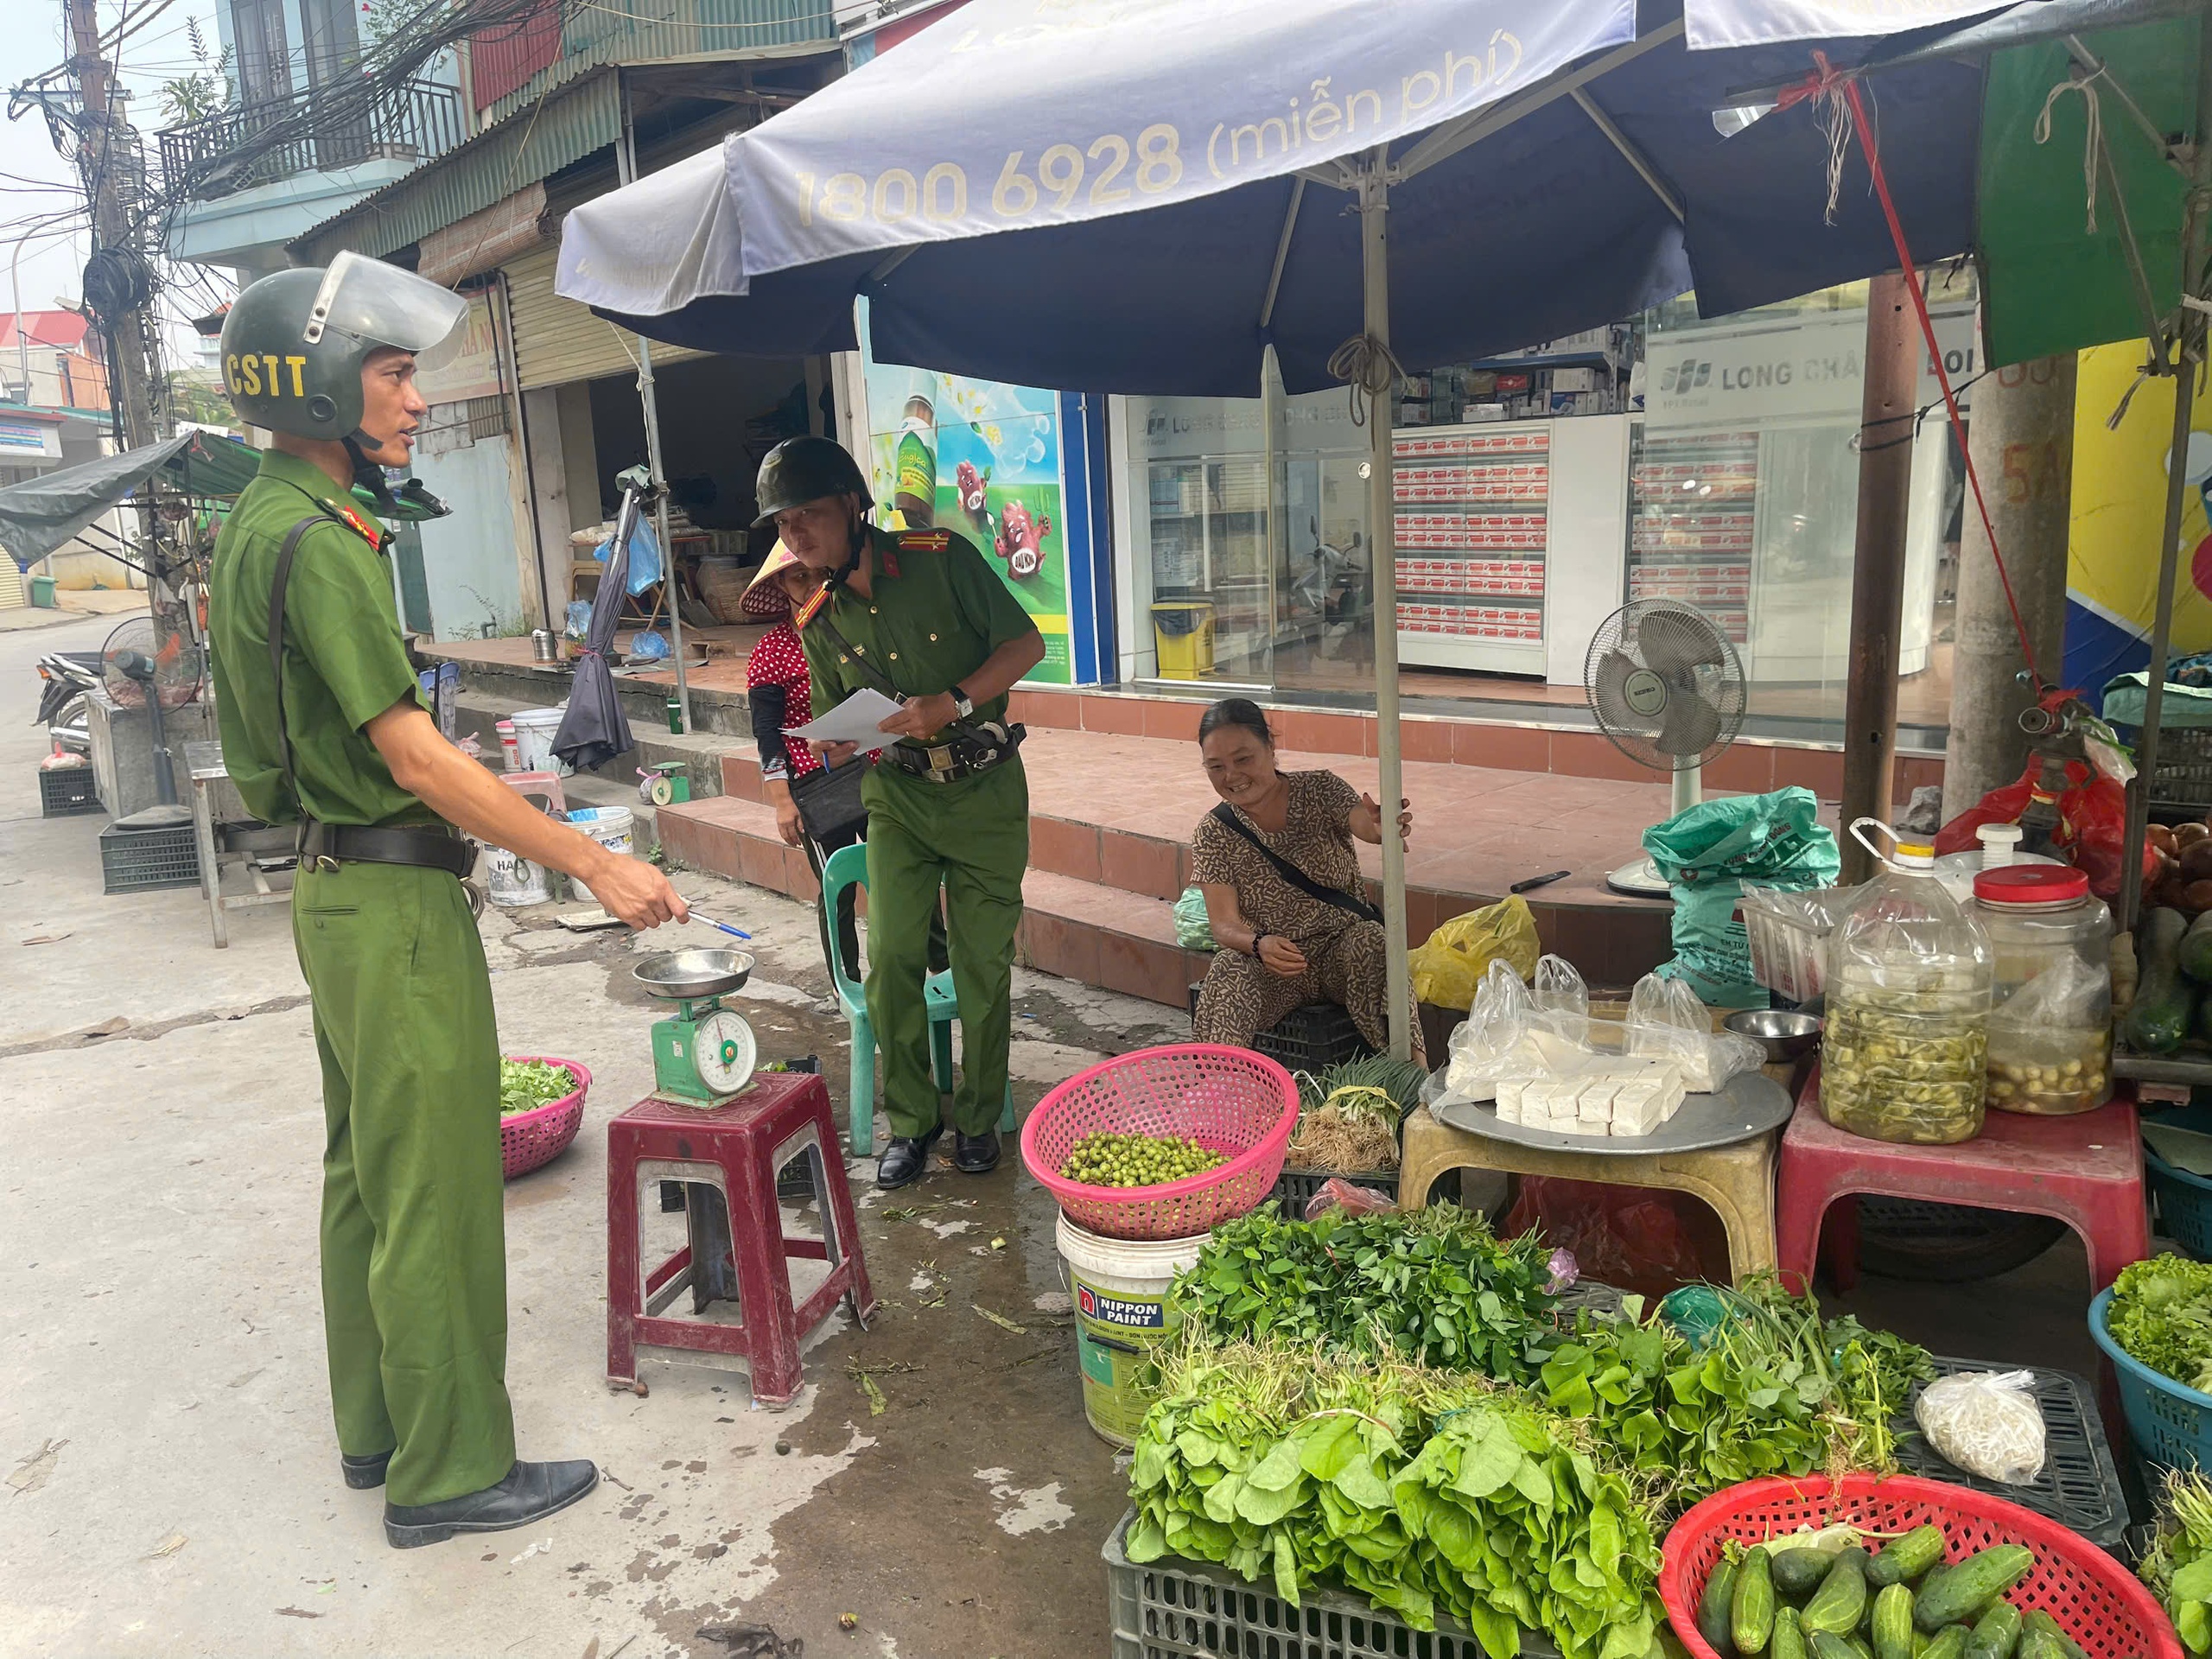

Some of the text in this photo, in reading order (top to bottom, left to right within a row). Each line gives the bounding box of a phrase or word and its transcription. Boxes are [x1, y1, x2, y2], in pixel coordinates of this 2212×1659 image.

[796, 29, 1523, 227] 1800 6928 (miễn phí)
[226, 353, 307, 397] CSTT
[1722, 361, 1792, 391] LONG
[1100, 1297, 1159, 1315] NIPPON
[1106, 1310, 1152, 1326] PAINT
